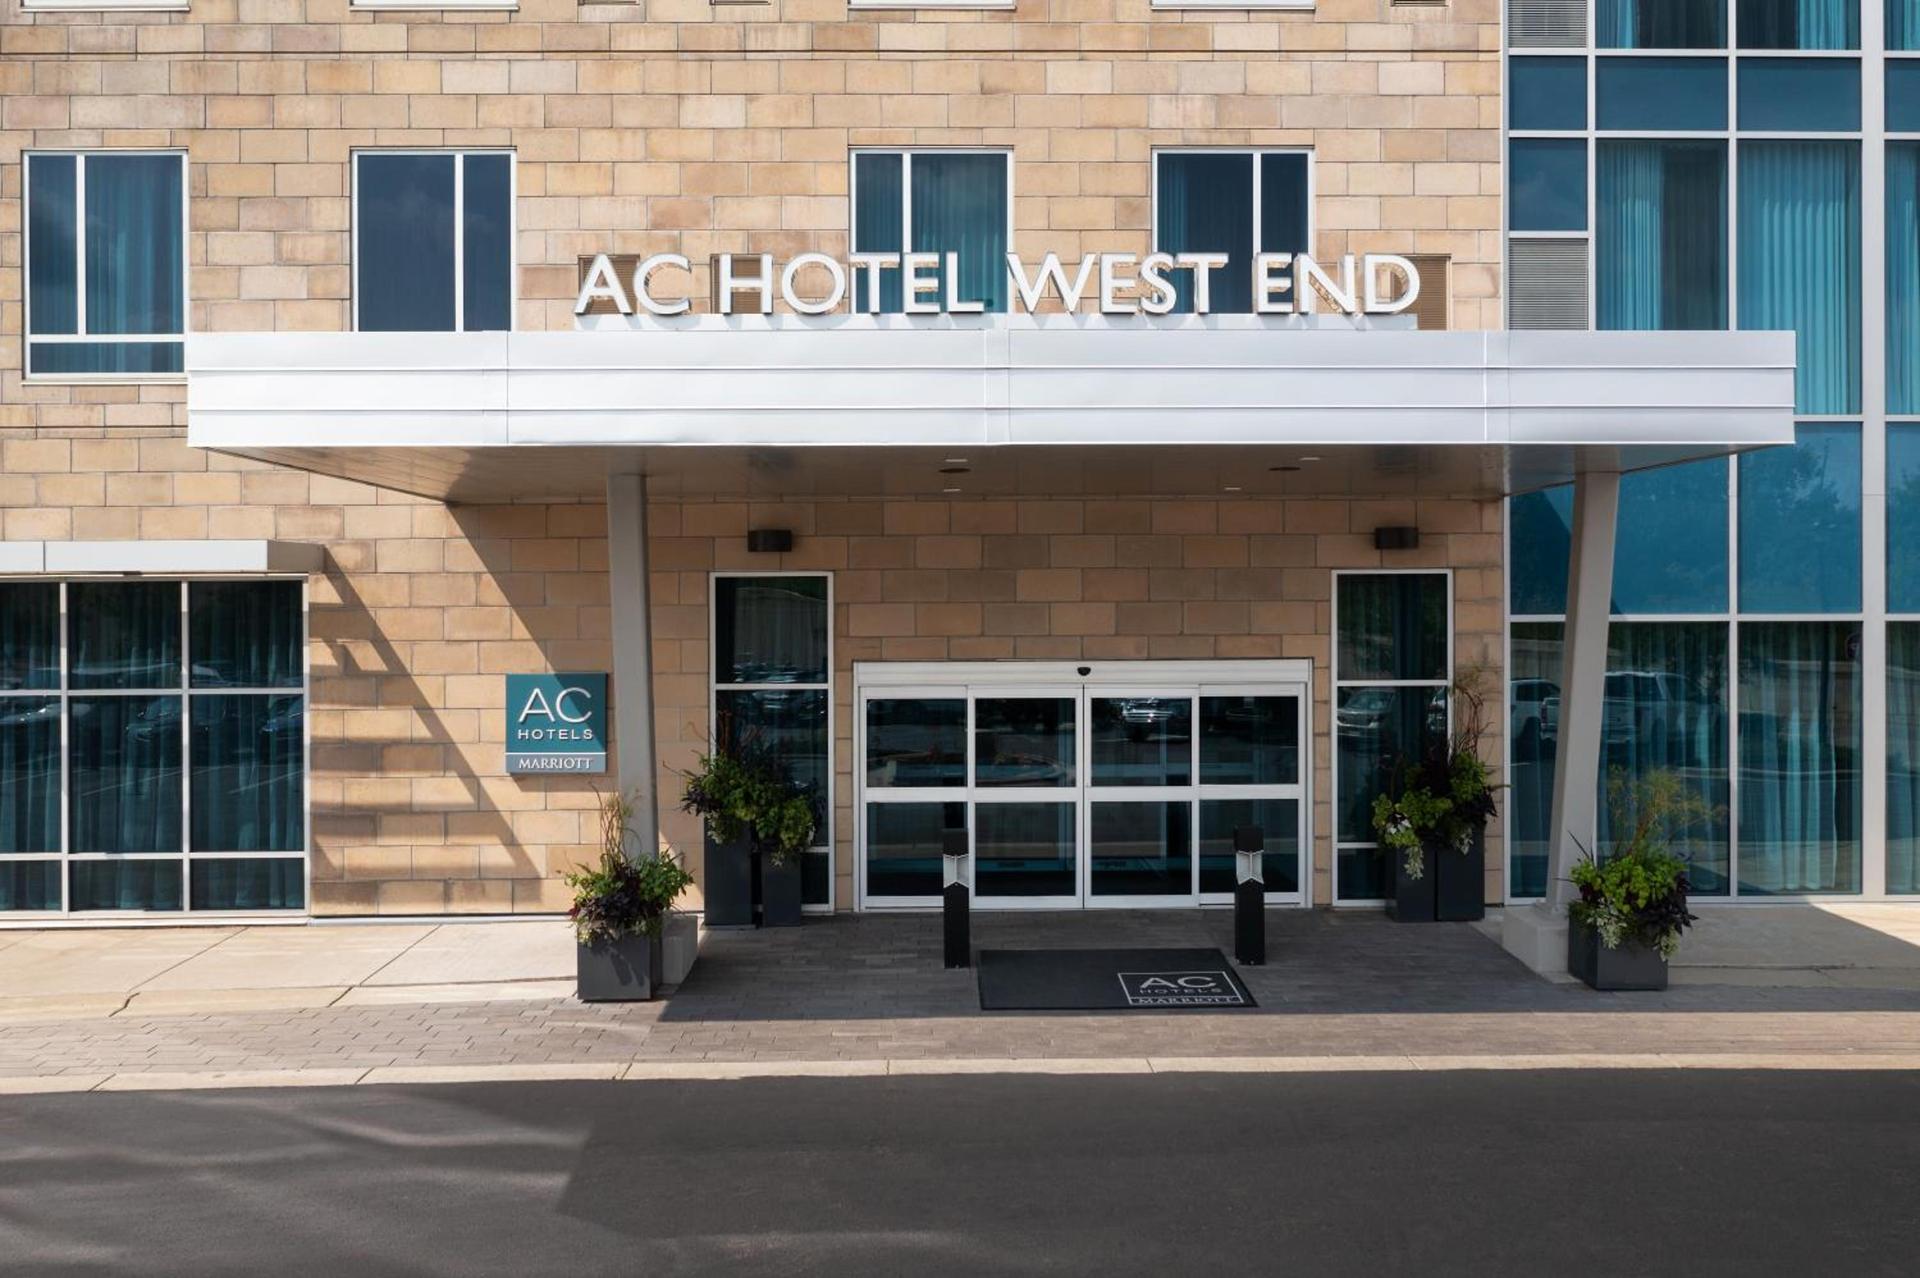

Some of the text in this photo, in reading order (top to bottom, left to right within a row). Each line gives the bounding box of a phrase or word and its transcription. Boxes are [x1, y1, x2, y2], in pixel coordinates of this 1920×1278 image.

[574, 252, 1421, 315] AC HOTEL WEST END
[518, 687, 592, 723] AC
[517, 728, 593, 740] HOTELS
[518, 757, 592, 769] MARRIOTT
[1139, 976, 1217, 988] AC
